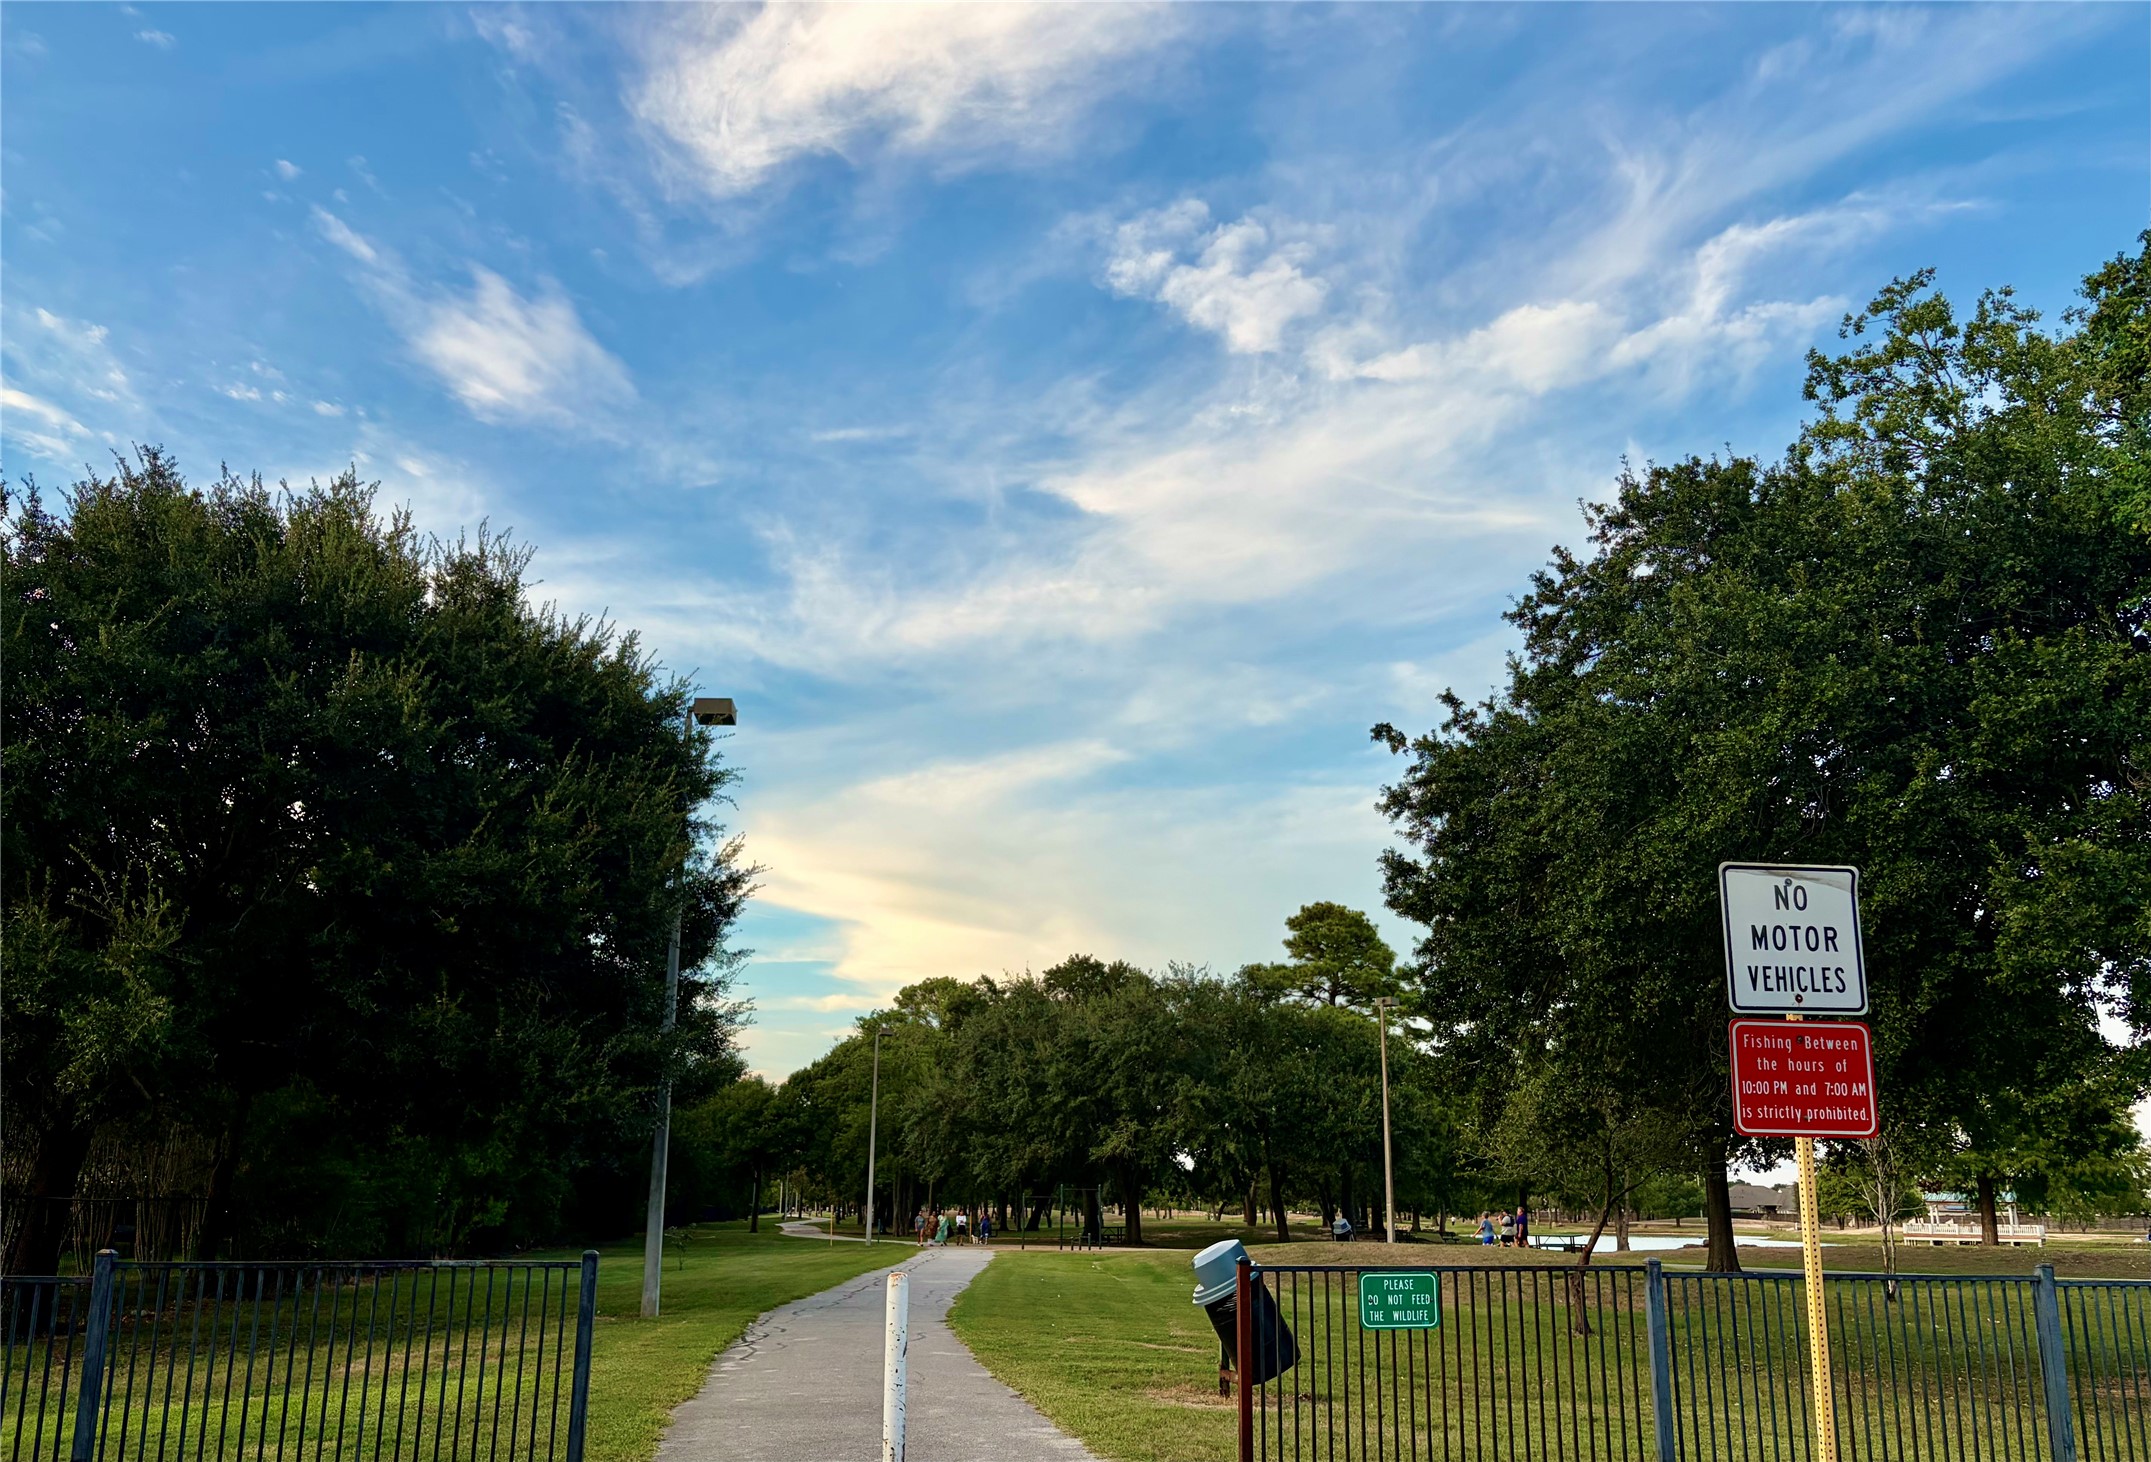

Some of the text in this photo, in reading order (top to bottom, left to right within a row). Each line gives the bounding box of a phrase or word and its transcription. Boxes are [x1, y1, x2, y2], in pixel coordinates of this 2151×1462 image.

[1774, 885, 1808, 911] NO
[1751, 924, 1839, 952] MOTOR
[1747, 965, 1846, 993] VEHICLES
[1744, 1034, 1858, 1053] Fishing Between
[1757, 1057, 1847, 1072] the hours of
[1742, 1081, 1867, 1096] 10:00 PM and 7:00 AM
[1742, 1104, 1869, 1123] is strictly prohibited.
[1384, 1280, 1414, 1290] PLEASE
[1388, 1295, 1402, 1305] NOT
[1412, 1294, 1430, 1304] FEED
[1370, 1310, 1428, 1321] THE WILDLIFE
